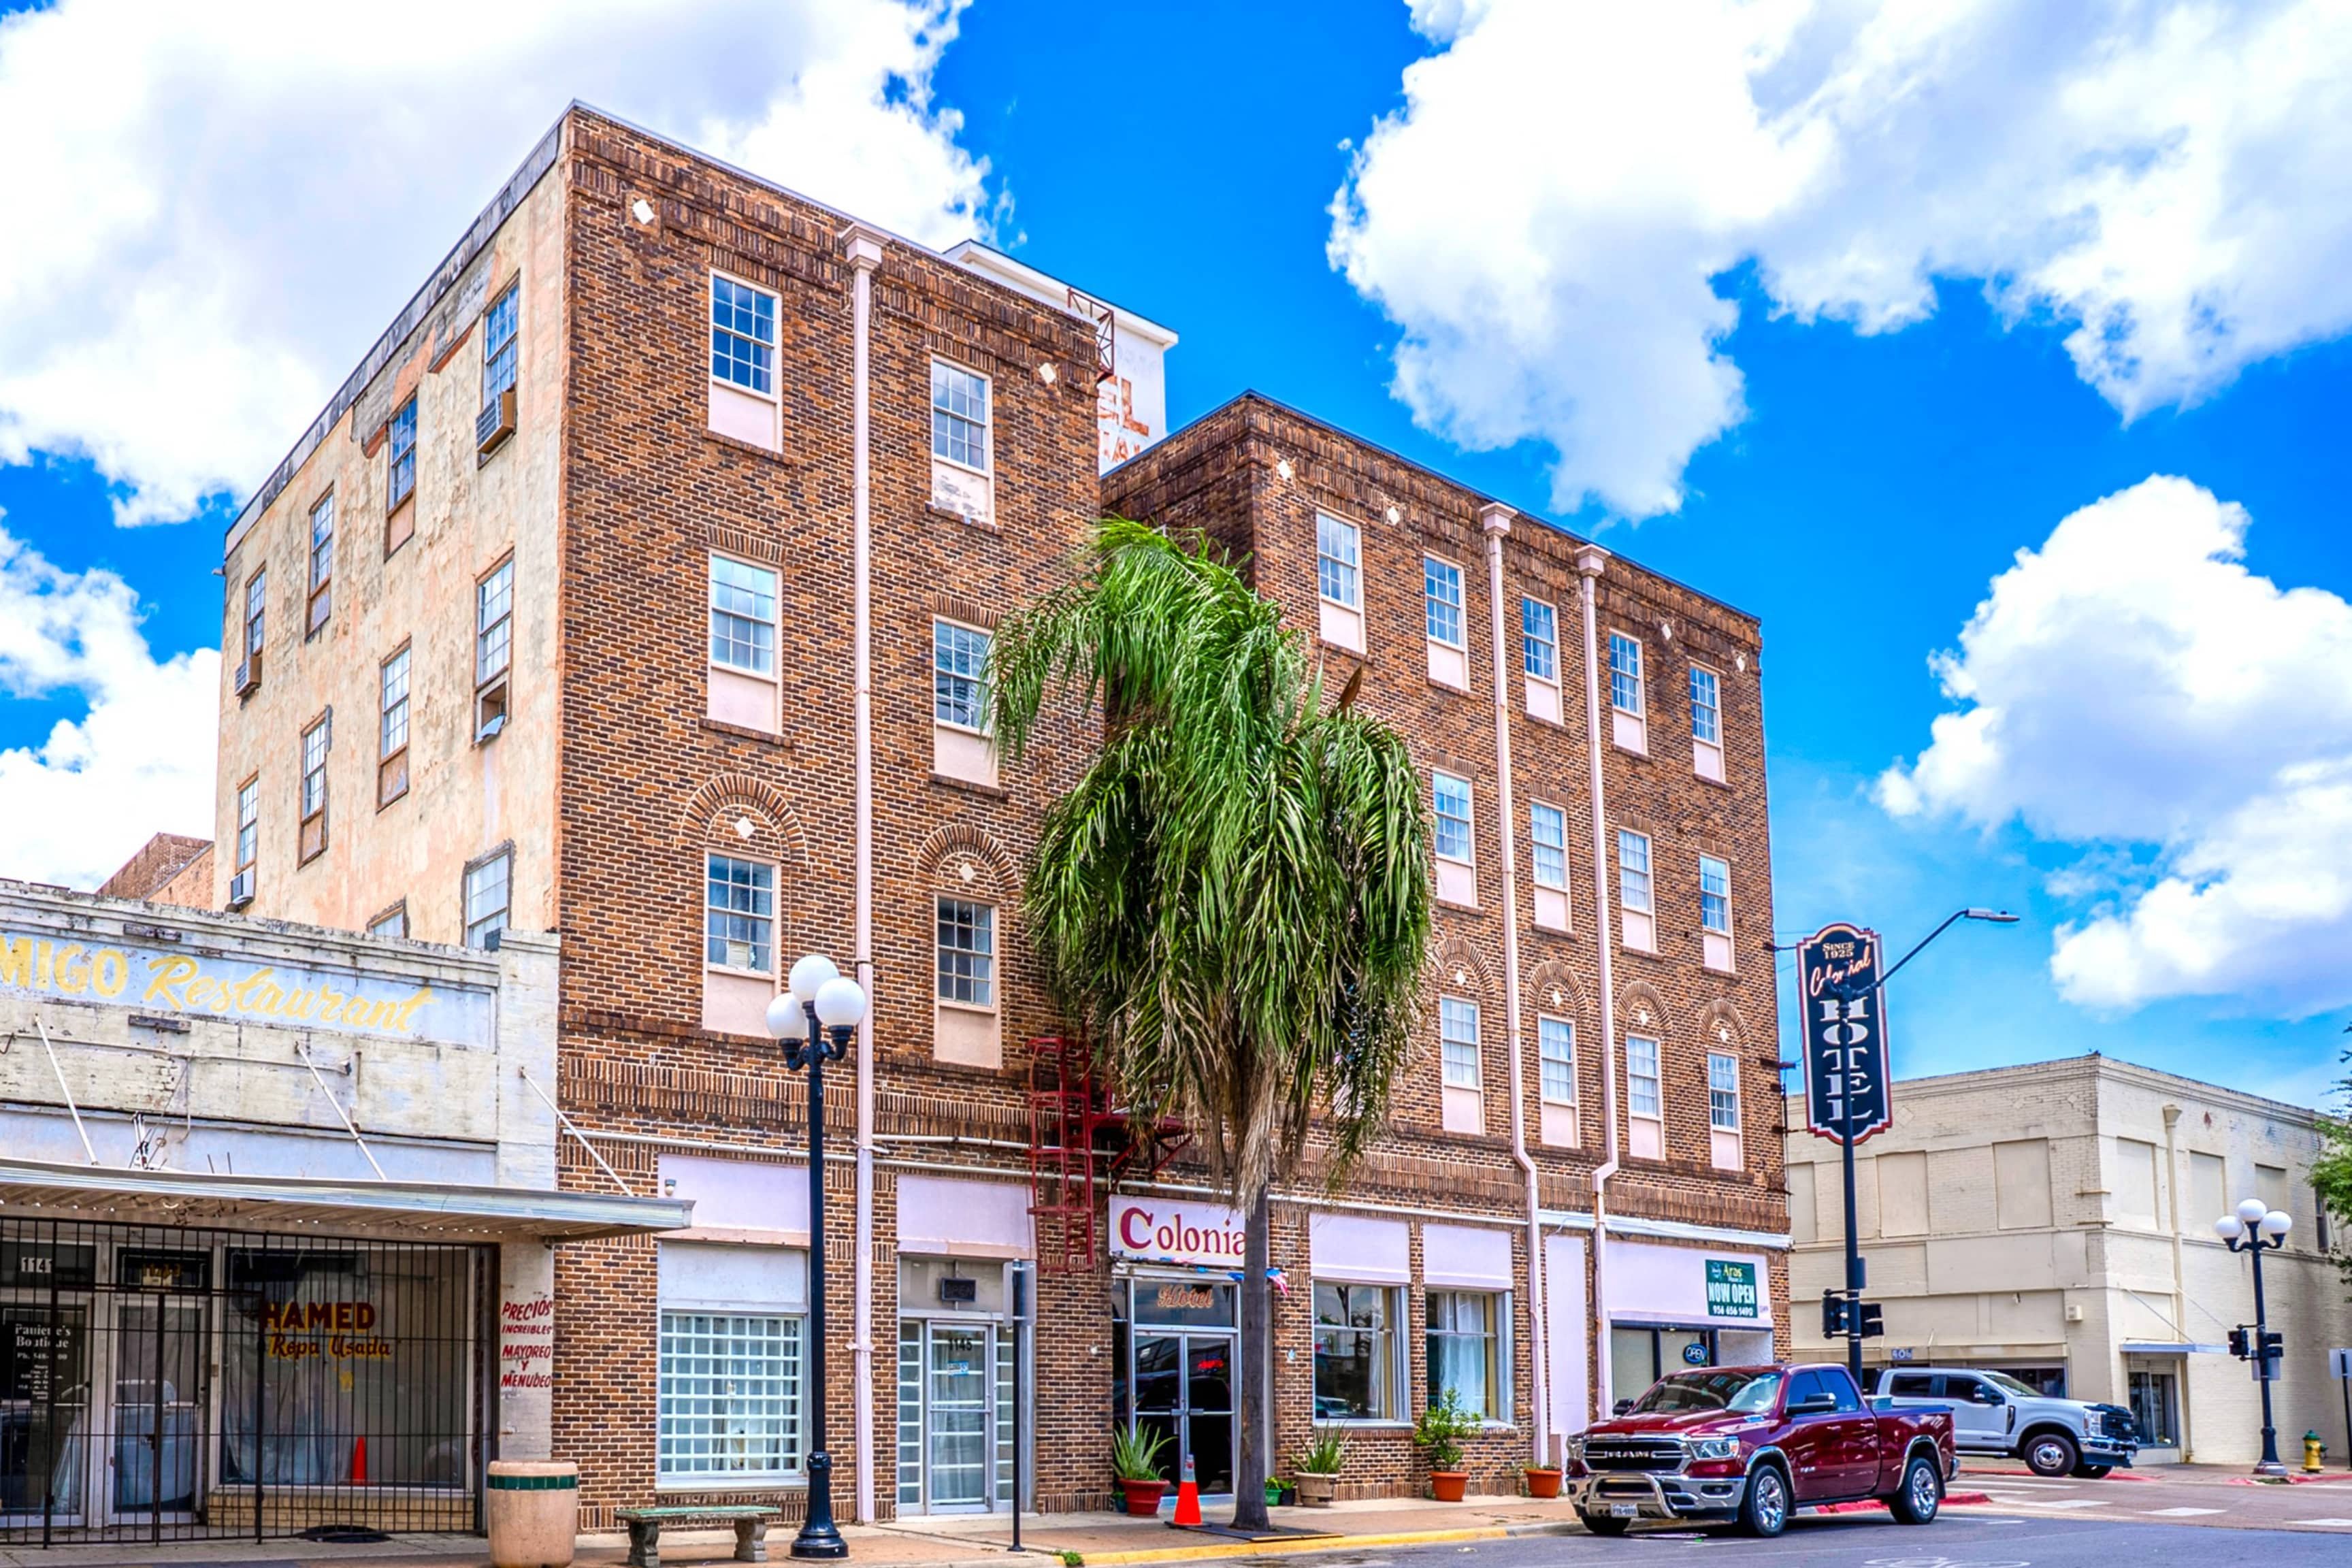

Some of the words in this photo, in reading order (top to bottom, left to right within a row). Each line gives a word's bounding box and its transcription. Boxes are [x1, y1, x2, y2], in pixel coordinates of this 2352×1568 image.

[1825, 949, 1854, 960] 1925
[0, 932, 129, 998] MIGO
[143, 954, 434, 1032] Restaurant
[1818, 996, 1873, 1122] HOTEL
[1120, 1207, 1246, 1256] Colonia
[1158, 1284, 1214, 1308] Hotel
[1708, 1282, 1730, 1303] NOW
[1731, 1284, 1755, 1304] OPEN
[502, 1300, 553, 1320] PRECIOS
[502, 1324, 552, 1335] INCREIBLES
[269, 1332, 320, 1360] Ropa
[328, 1334, 393, 1359] Usada
[502, 1345, 551, 1359] MAYOREO
[947, 1337, 973, 1351] 1145
[1686, 1346, 1705, 1360] OPEN
[521, 1360, 529, 1371] Y
[501, 1373, 551, 1388] MENUDEO
